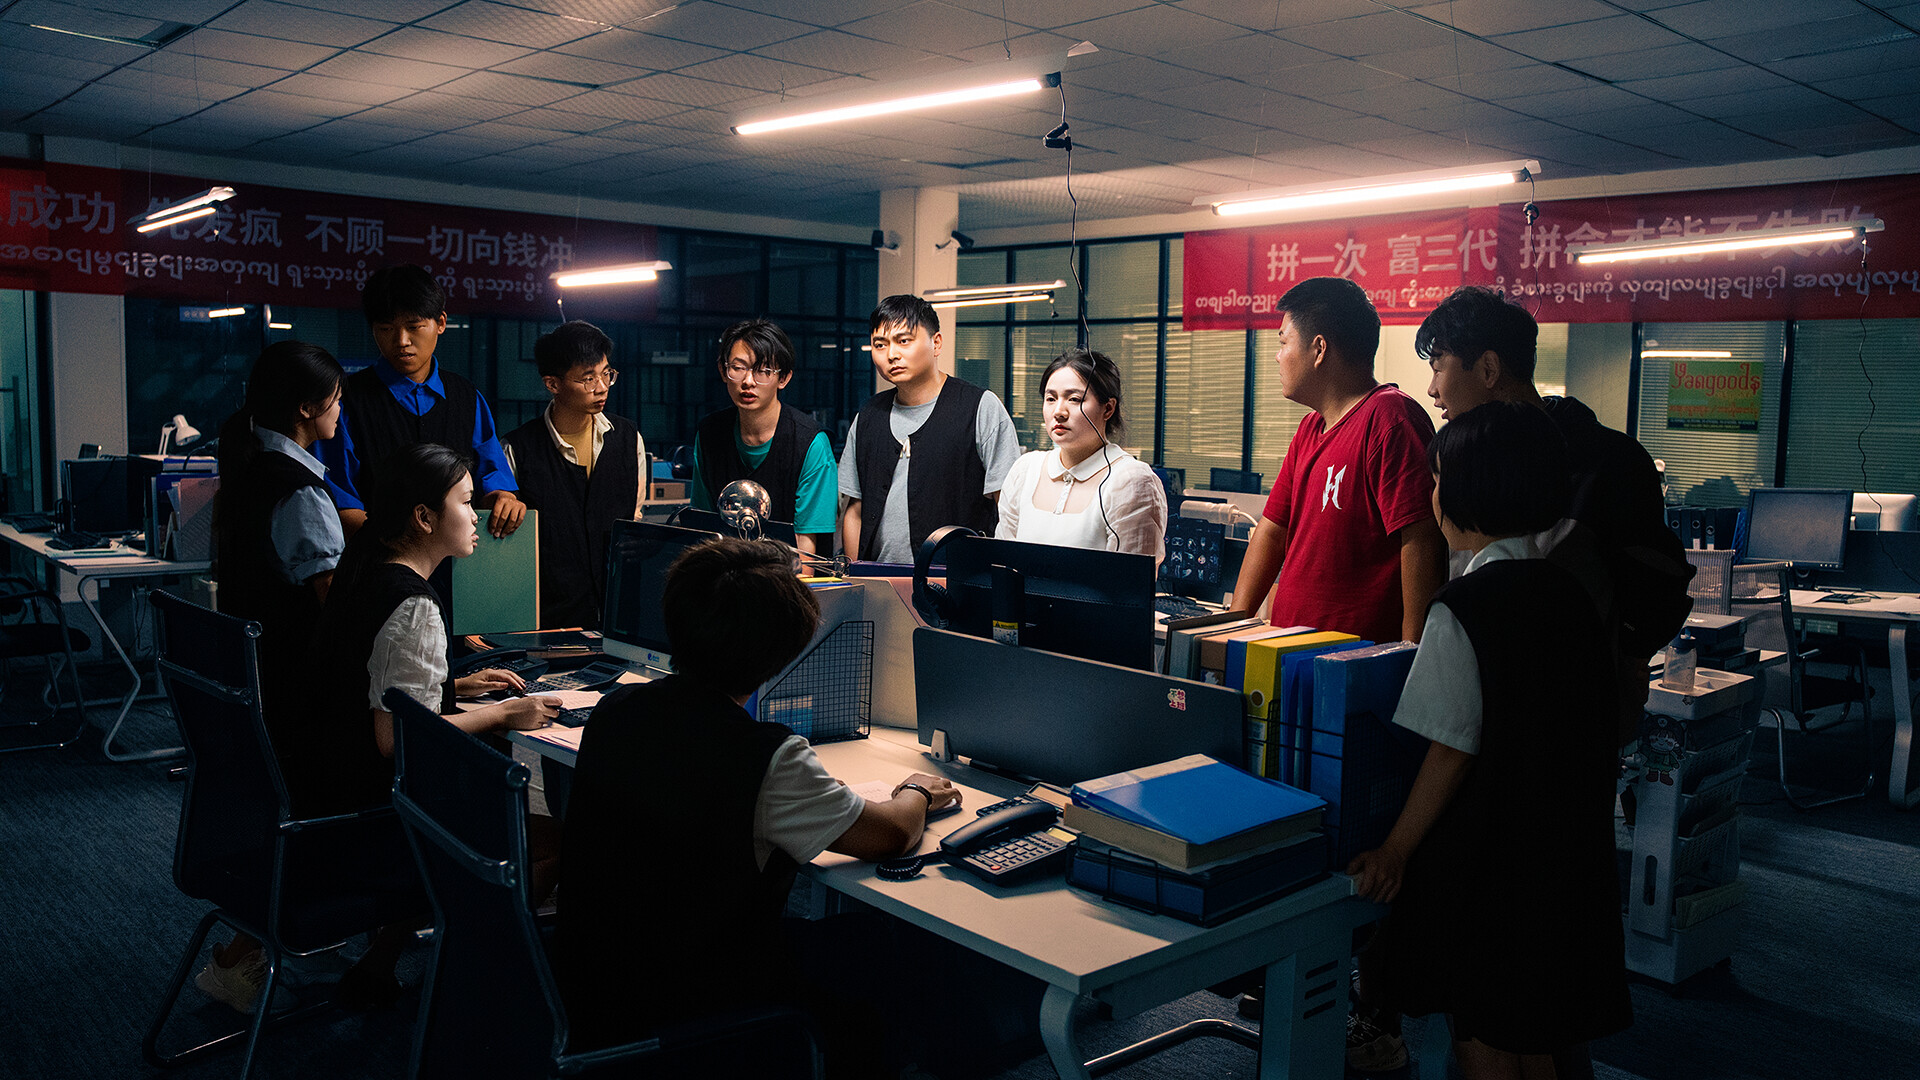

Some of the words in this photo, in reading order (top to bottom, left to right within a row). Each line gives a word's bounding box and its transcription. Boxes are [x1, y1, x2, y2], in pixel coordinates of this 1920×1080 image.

[305, 214, 573, 271] 不顾一切向钱冲
[1267, 237, 1368, 282] 拼一次
[1387, 229, 1498, 276] 富三代
